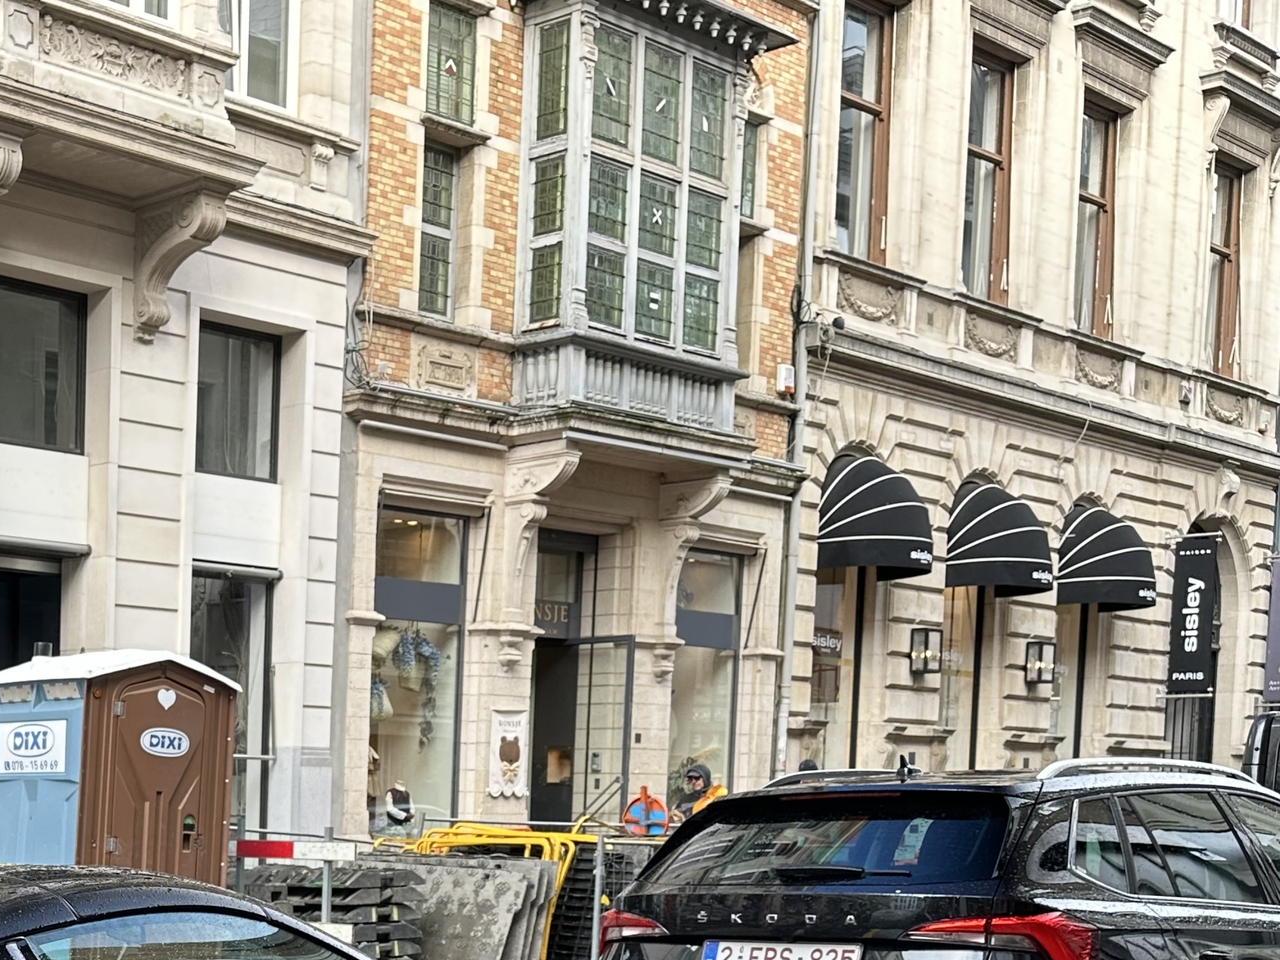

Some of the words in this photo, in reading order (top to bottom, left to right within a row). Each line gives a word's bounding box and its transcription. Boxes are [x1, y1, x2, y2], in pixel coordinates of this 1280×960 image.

[1180, 577, 1206, 653] sisley
[811, 633, 842, 652] sisley
[1171, 671, 1205, 681] PARIS
[696, 910, 858, 926] ŠKODA
